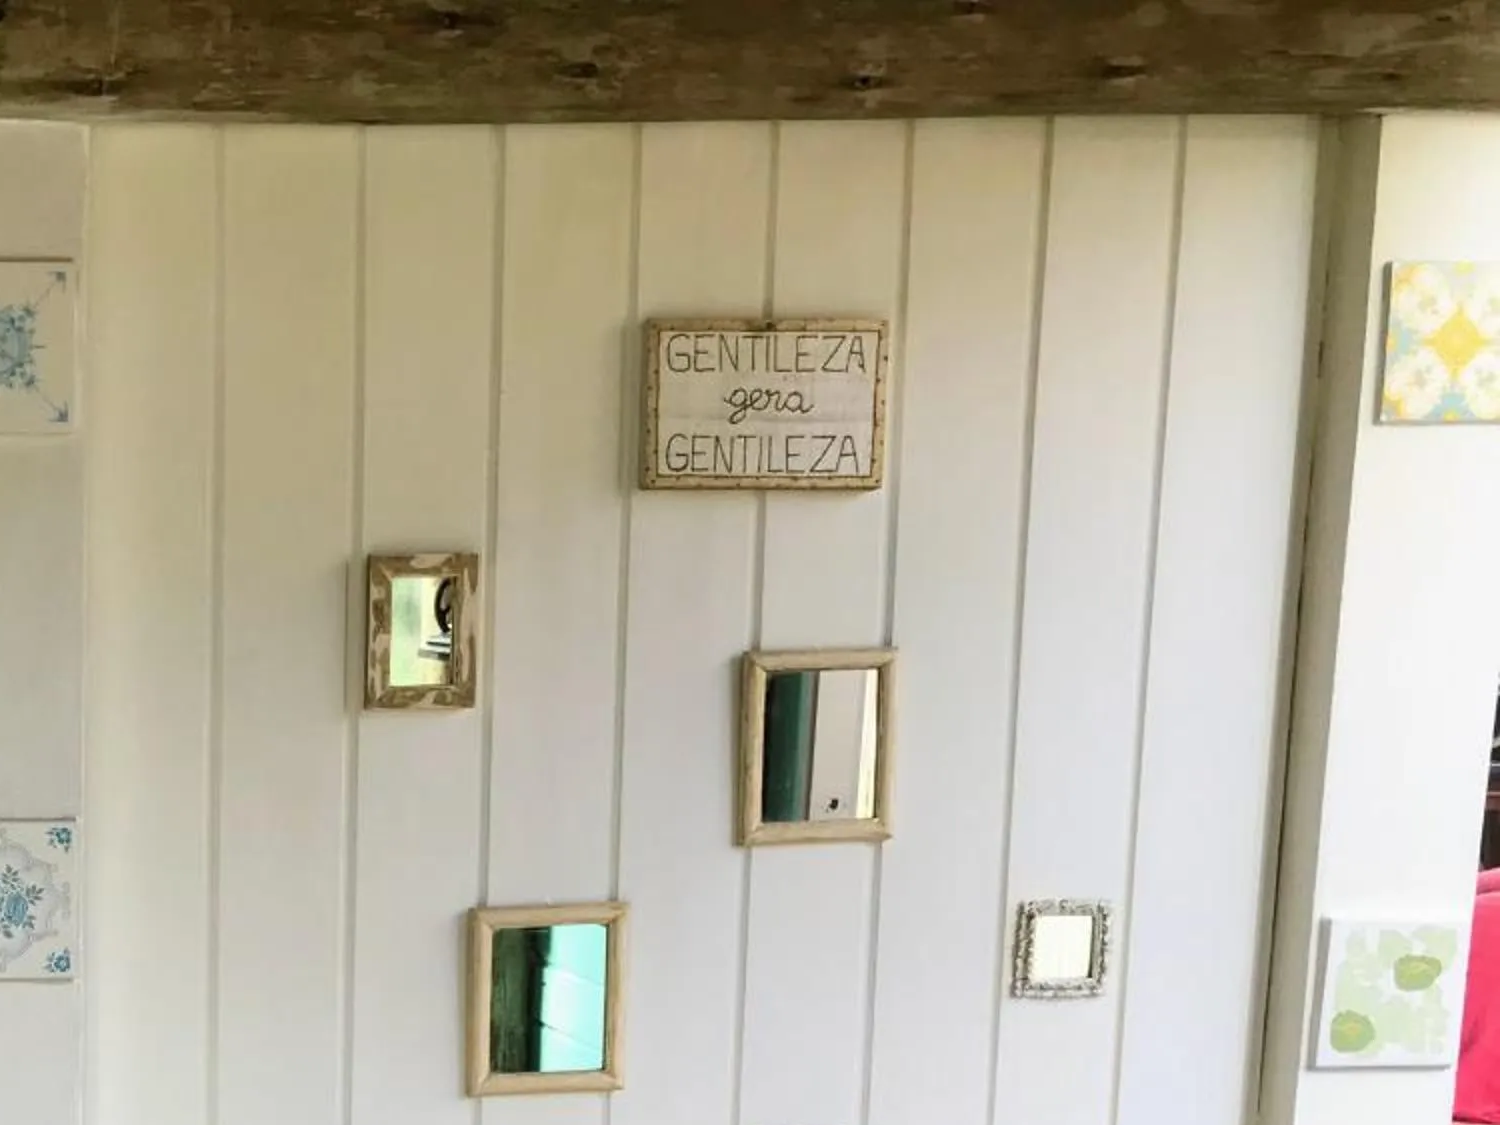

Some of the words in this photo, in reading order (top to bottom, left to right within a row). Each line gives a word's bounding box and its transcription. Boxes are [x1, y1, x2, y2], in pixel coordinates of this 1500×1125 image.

[666, 333, 866, 373] GENTILEZA
[724, 387, 815, 424] gera
[665, 433, 859, 473] GENTILEZA
